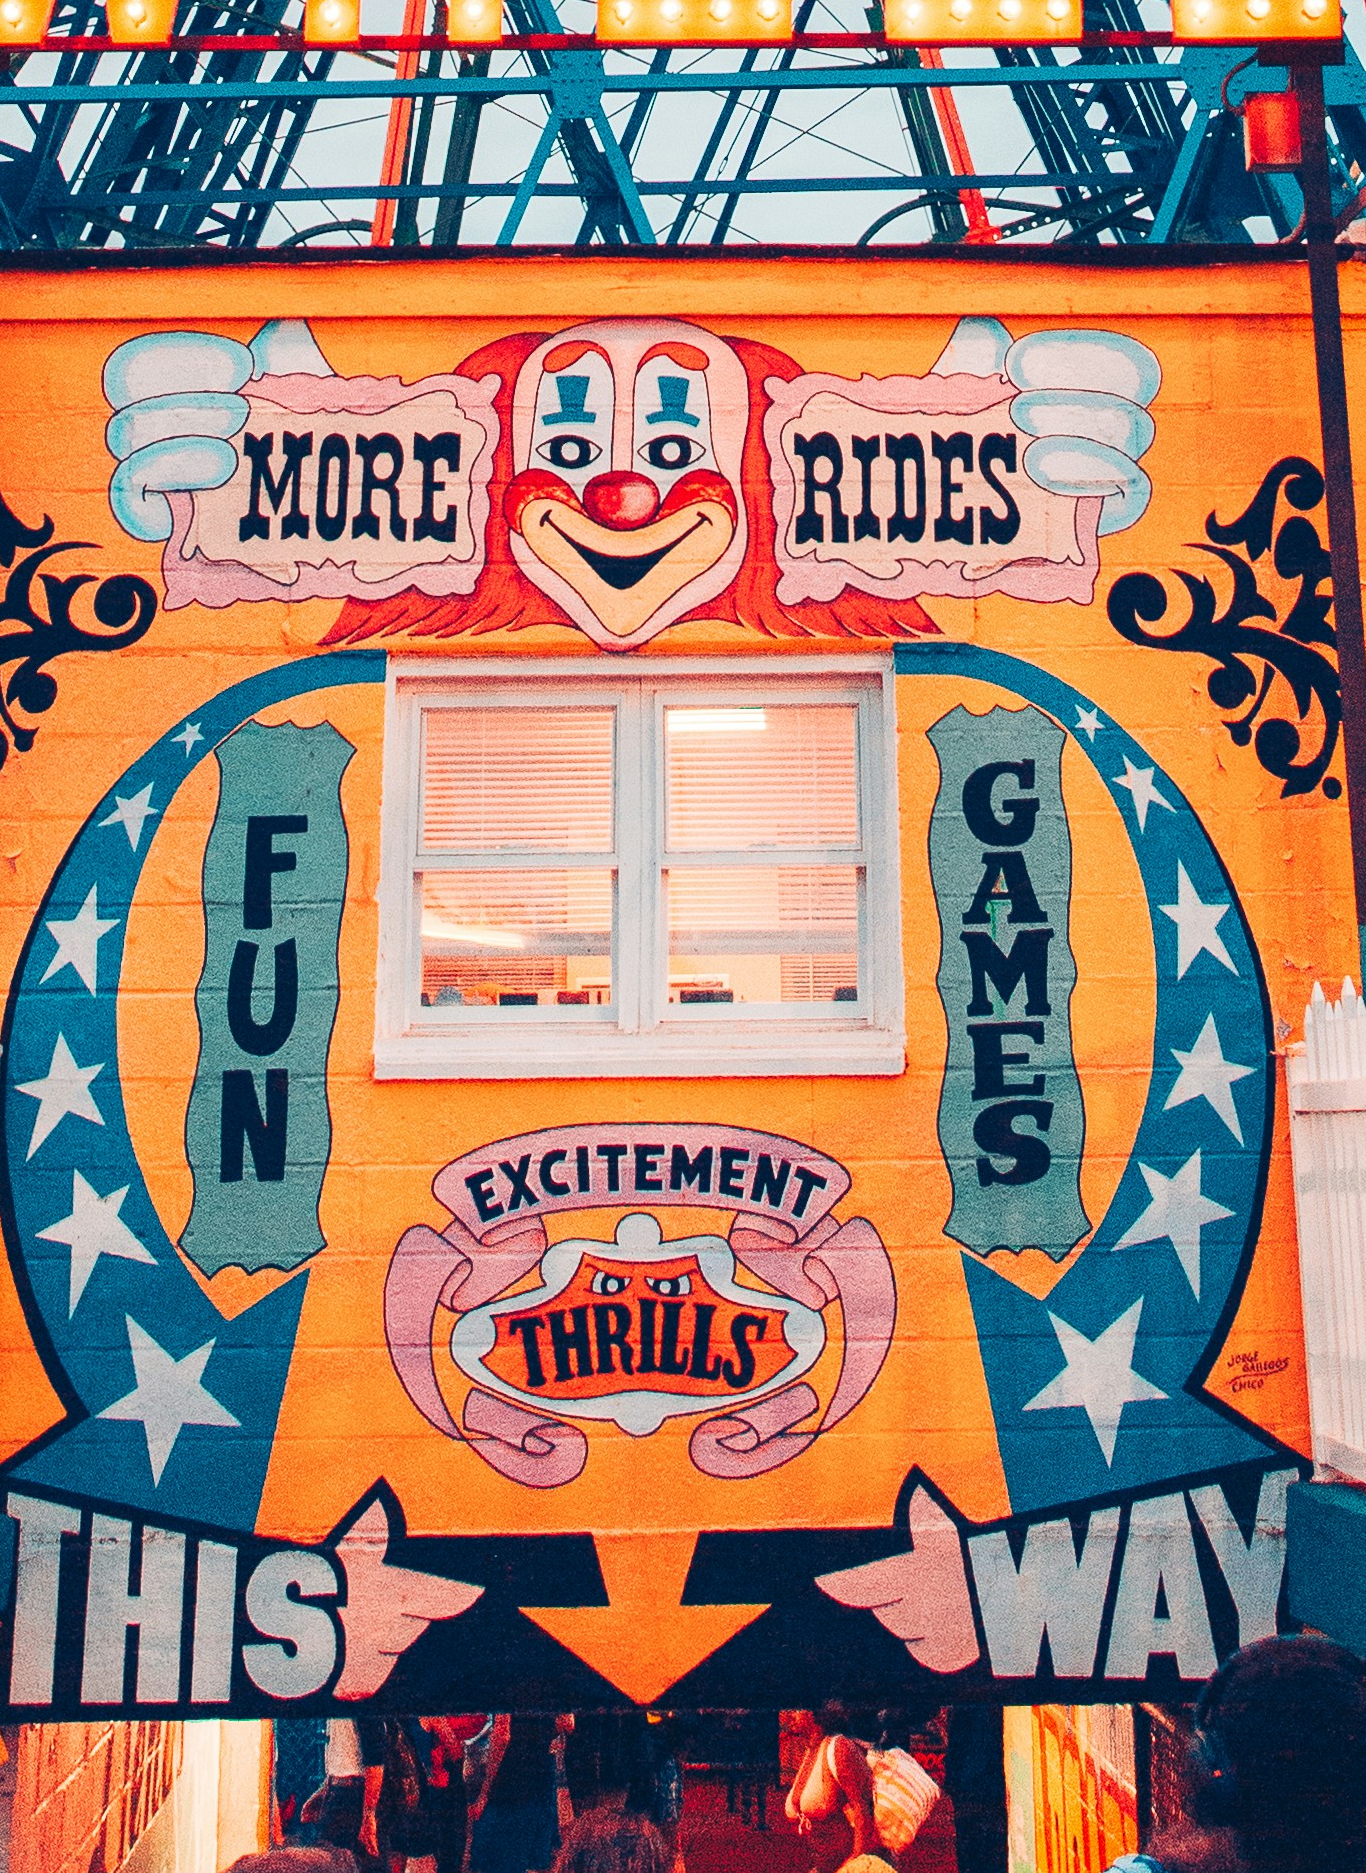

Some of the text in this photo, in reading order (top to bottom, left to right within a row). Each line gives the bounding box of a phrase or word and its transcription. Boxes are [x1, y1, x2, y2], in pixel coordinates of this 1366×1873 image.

[238, 432, 1021, 545] MORE RIDES
[220, 815, 308, 1183] FUN
[960, 759, 1054, 1188] GAMES
[465, 1144, 829, 1223] EXCITEMENT
[509, 1298, 769, 1389] THRILLS
[7, 1468, 1300, 1705] THIS WAY
